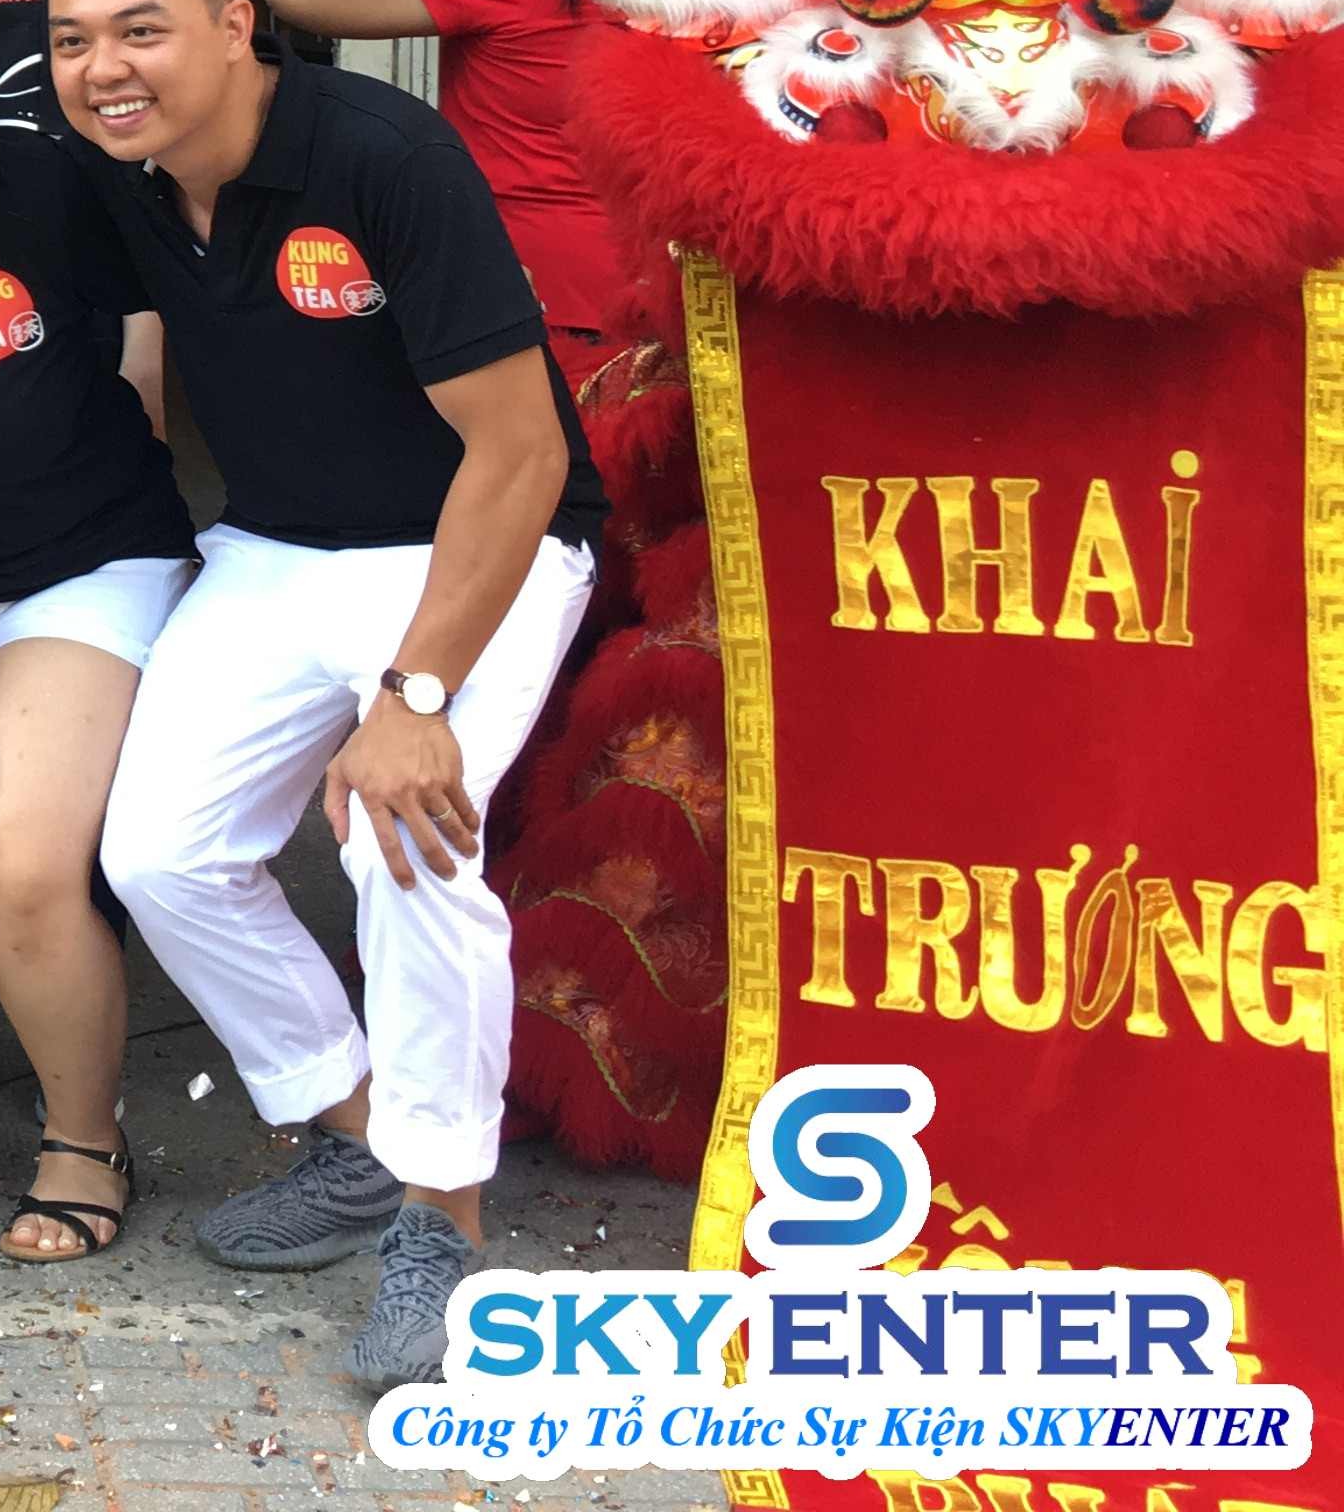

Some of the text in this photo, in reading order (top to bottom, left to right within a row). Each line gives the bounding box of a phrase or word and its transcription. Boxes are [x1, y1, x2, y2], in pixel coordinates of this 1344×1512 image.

[288, 239, 350, 266] KUNG
[288, 263, 319, 287] FU
[291, 286, 338, 309] TEA
